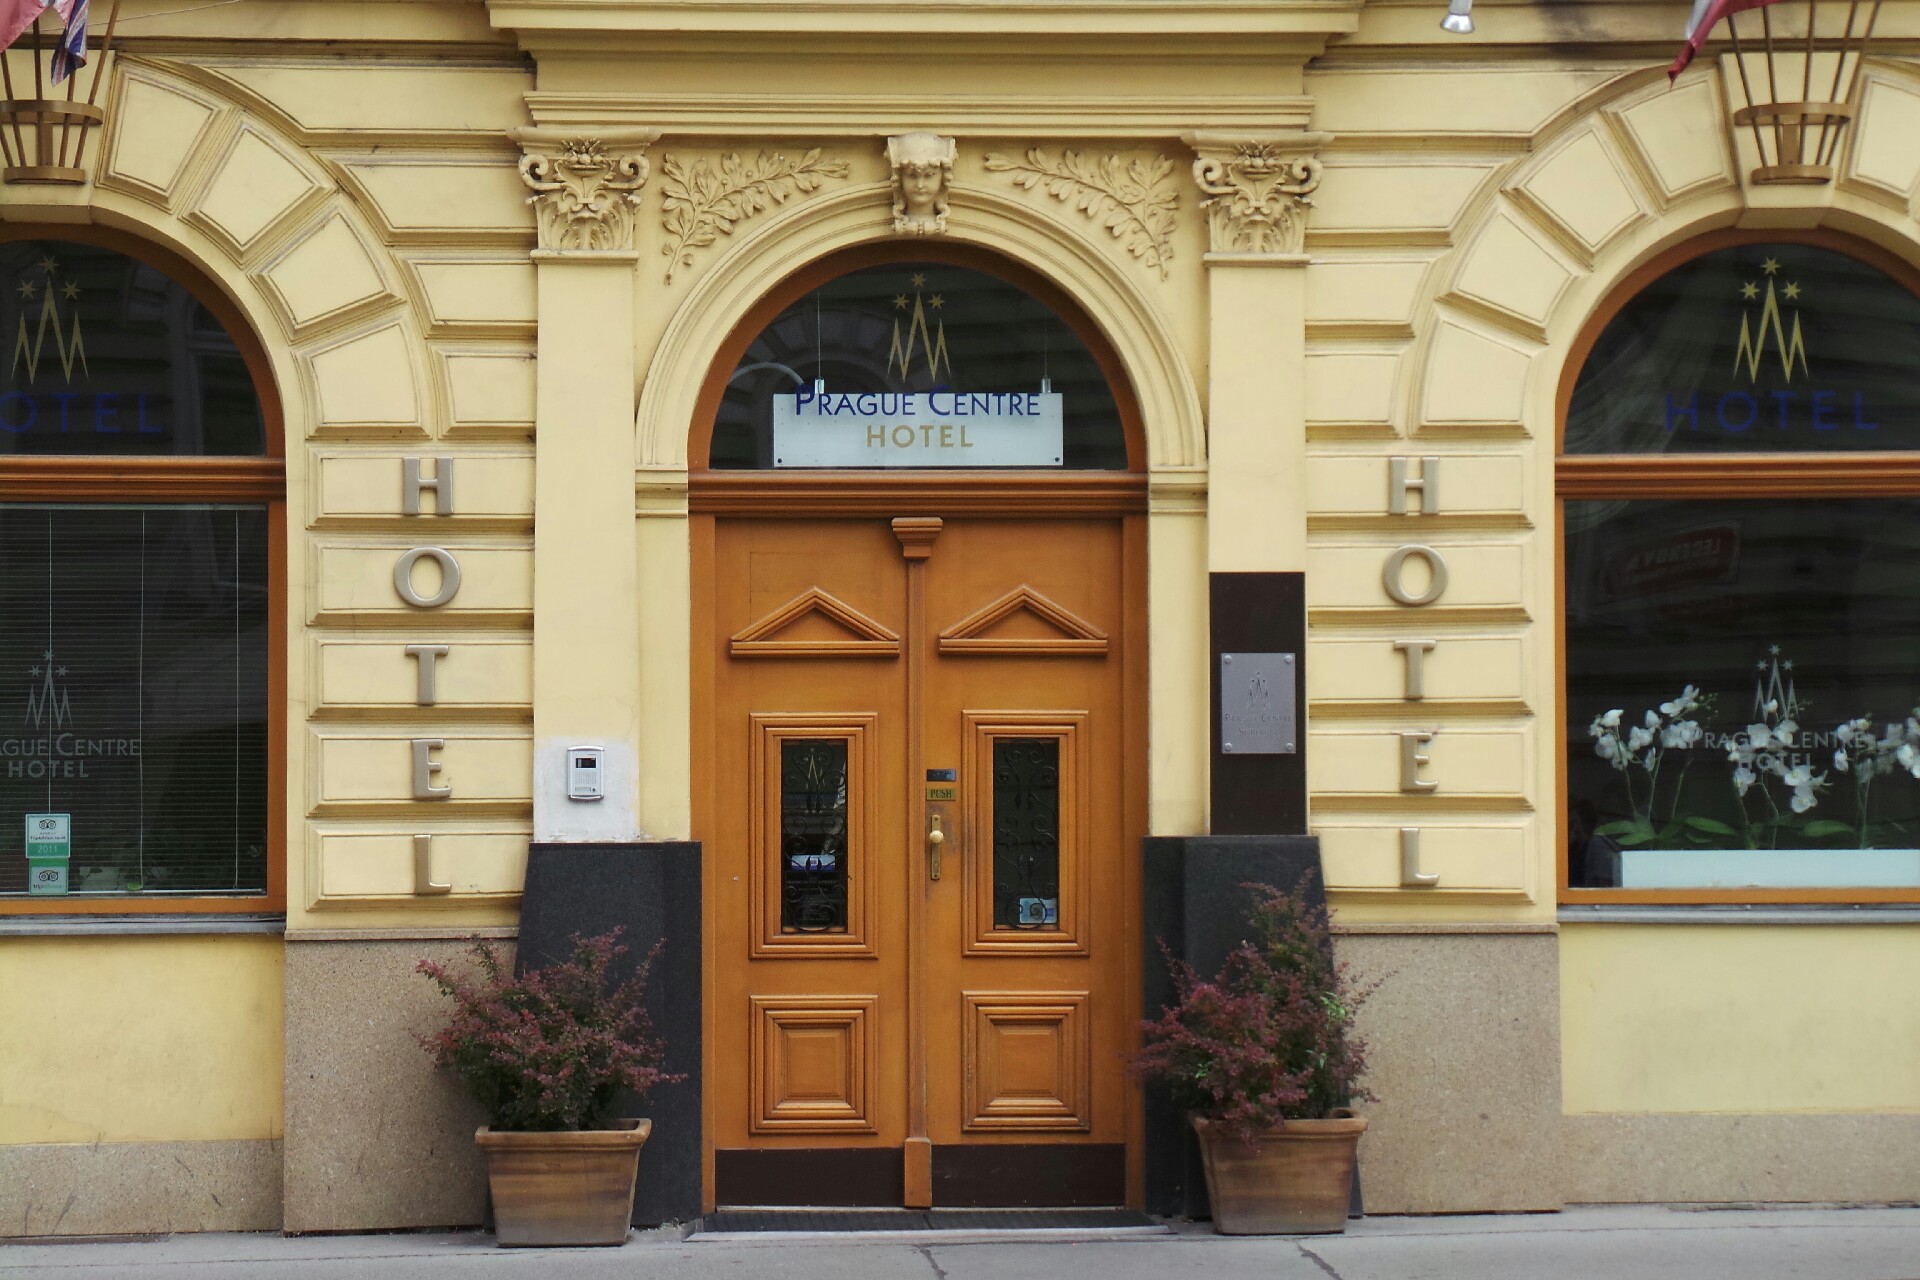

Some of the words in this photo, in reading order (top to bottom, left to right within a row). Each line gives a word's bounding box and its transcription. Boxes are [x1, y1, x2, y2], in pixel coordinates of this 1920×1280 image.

[1665, 390, 1880, 433] HOTEL
[866, 424, 974, 448] HOTEL
[393, 456, 462, 896] HOTEL
[1382, 456, 1449, 888] HOTEL
[0, 738, 49, 756] GUE
[56, 732, 141, 757] CENTRE
[8, 759, 90, 778] HOTEL
[930, 789, 952, 799] PUSH
[37, 845, 58, 853] 2011
